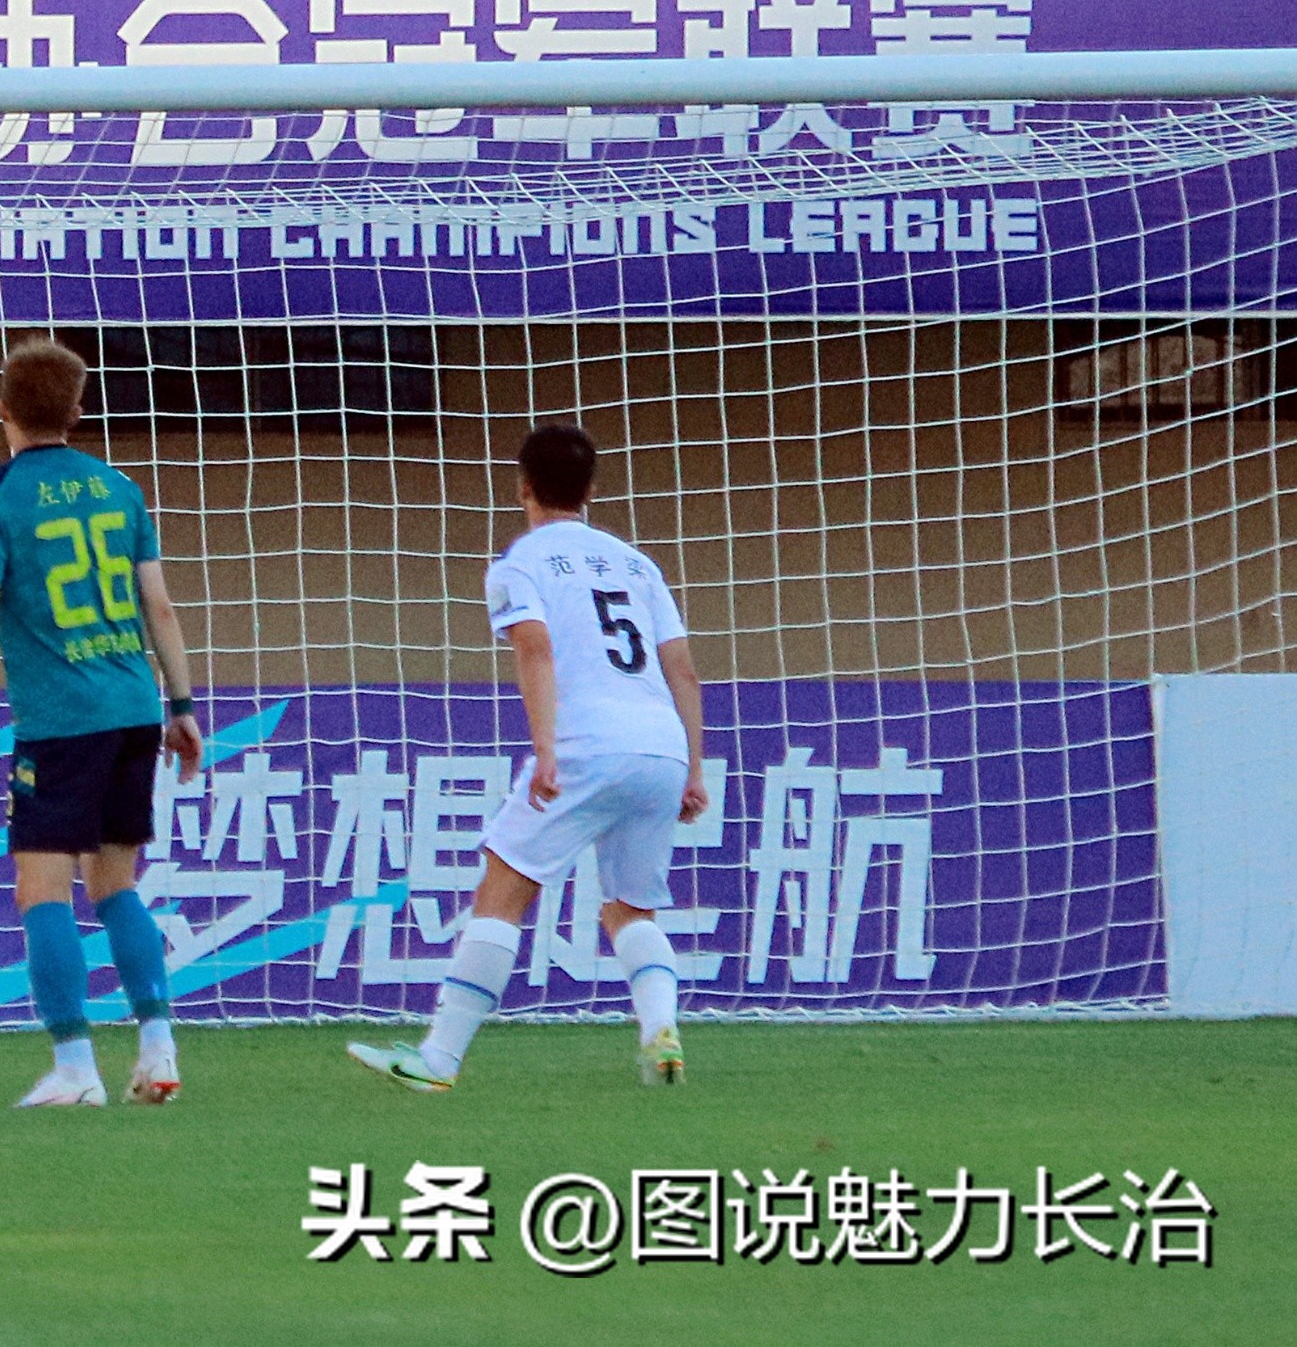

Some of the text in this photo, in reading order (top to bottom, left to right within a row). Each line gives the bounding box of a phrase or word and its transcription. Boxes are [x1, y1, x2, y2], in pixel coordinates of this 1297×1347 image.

[270, 202, 717, 258] CHAMPIONS
[748, 199, 1039, 252] LEAGUE
[35, 512, 137, 630] 26
[591, 588, 647, 675] 5
